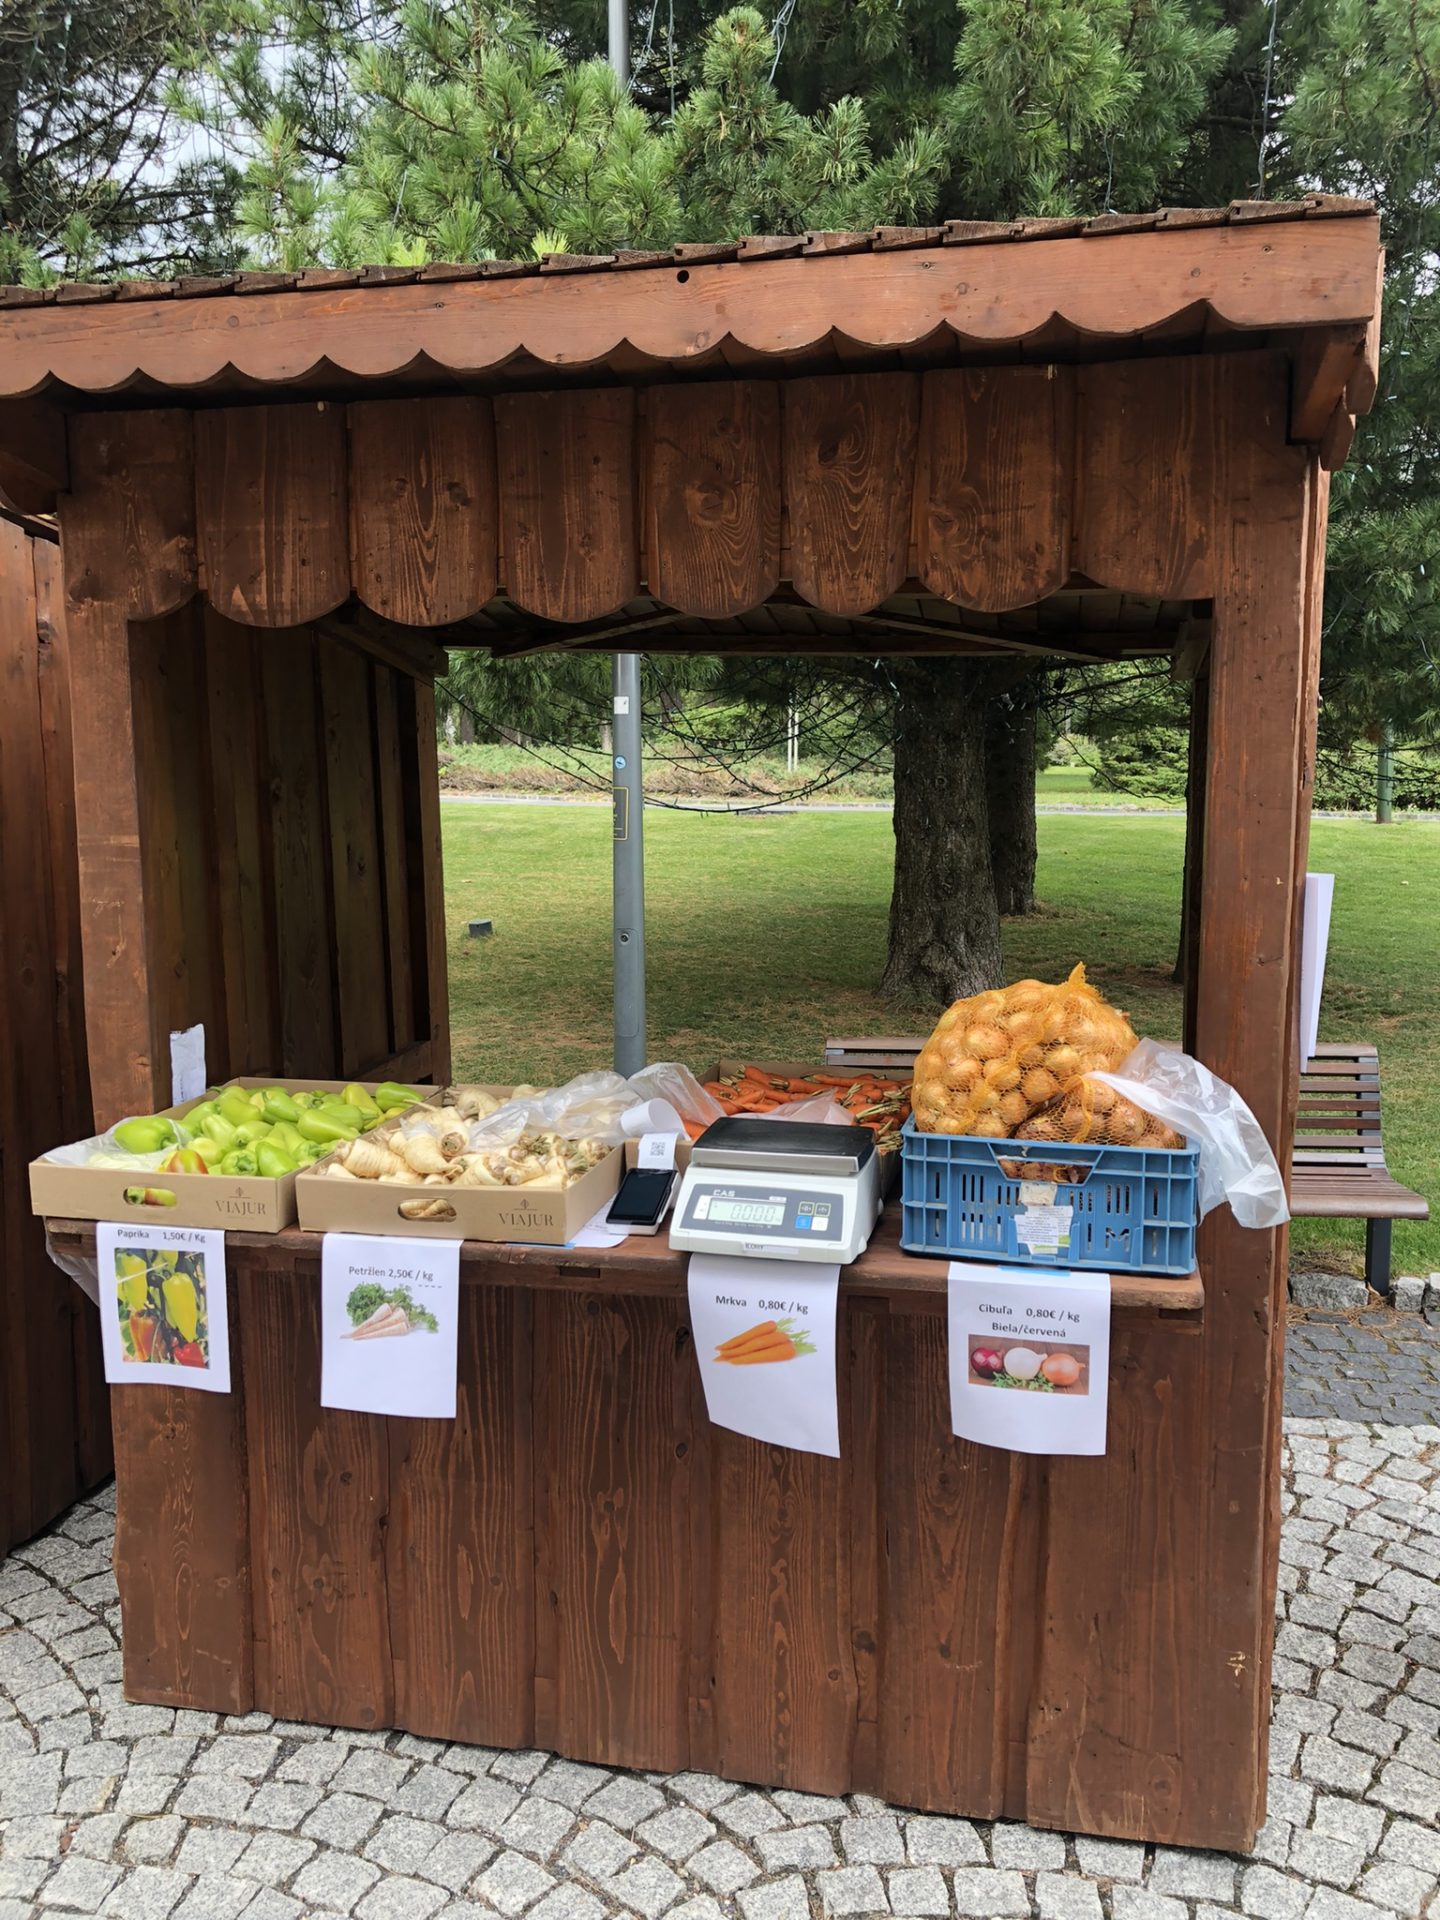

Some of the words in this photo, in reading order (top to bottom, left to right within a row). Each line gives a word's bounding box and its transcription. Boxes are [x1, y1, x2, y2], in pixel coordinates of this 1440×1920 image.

[713, 1189, 736, 1198] CAS
[215, 1200, 267, 1216] VIAJUR
[498, 1212, 555, 1228] VIAJUR
[117, 1229, 150, 1240] Paprika
[162, 1231, 186, 1241] 1,50€
[348, 1266, 386, 1277] Petržlen
[388, 1268, 414, 1280] 2,50€
[422, 1270, 434, 1282] kg
[715, 1295, 747, 1307] Mrkva
[758, 1299, 787, 1311] 0,80€
[796, 1303, 808, 1315] kg
[978, 1303, 1013, 1316] Cibuľa
[1025, 1307, 1056, 1320] 0,80€
[1067, 1311, 1080, 1323] kg
[991, 1322, 1066, 1338] Biela/červená
